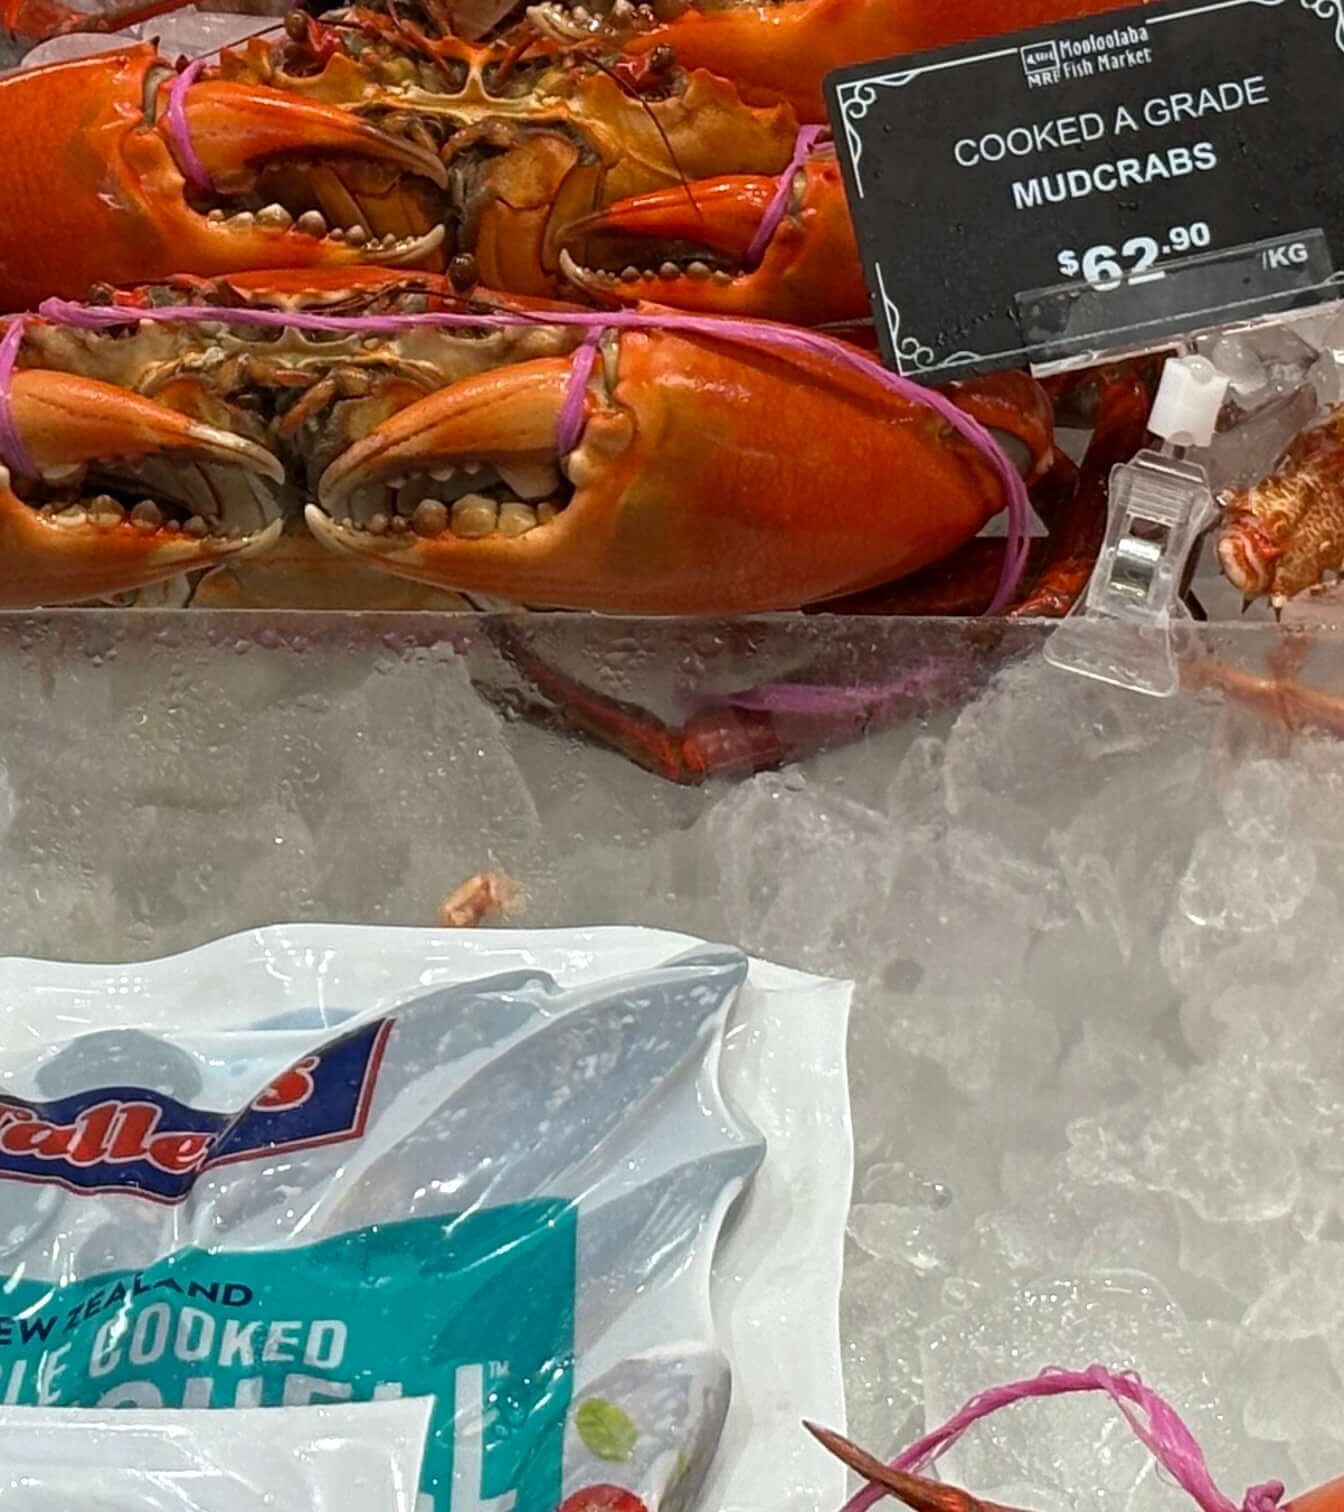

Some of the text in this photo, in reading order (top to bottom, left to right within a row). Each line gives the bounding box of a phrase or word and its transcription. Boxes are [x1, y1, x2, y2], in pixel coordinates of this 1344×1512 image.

[1059, 25, 1149, 59] Mooloolaba
[1063, 48, 1152, 79] Fish Market
[954, 76, 1270, 169] COOKED A GRADE
[1012, 142, 1218, 210] MUDCRABS
[1058, 222, 1309, 291] $62.90 /KG
[64, 1271, 254, 1334] ZEALAND
[88, 1302, 348, 1379] COOKED
